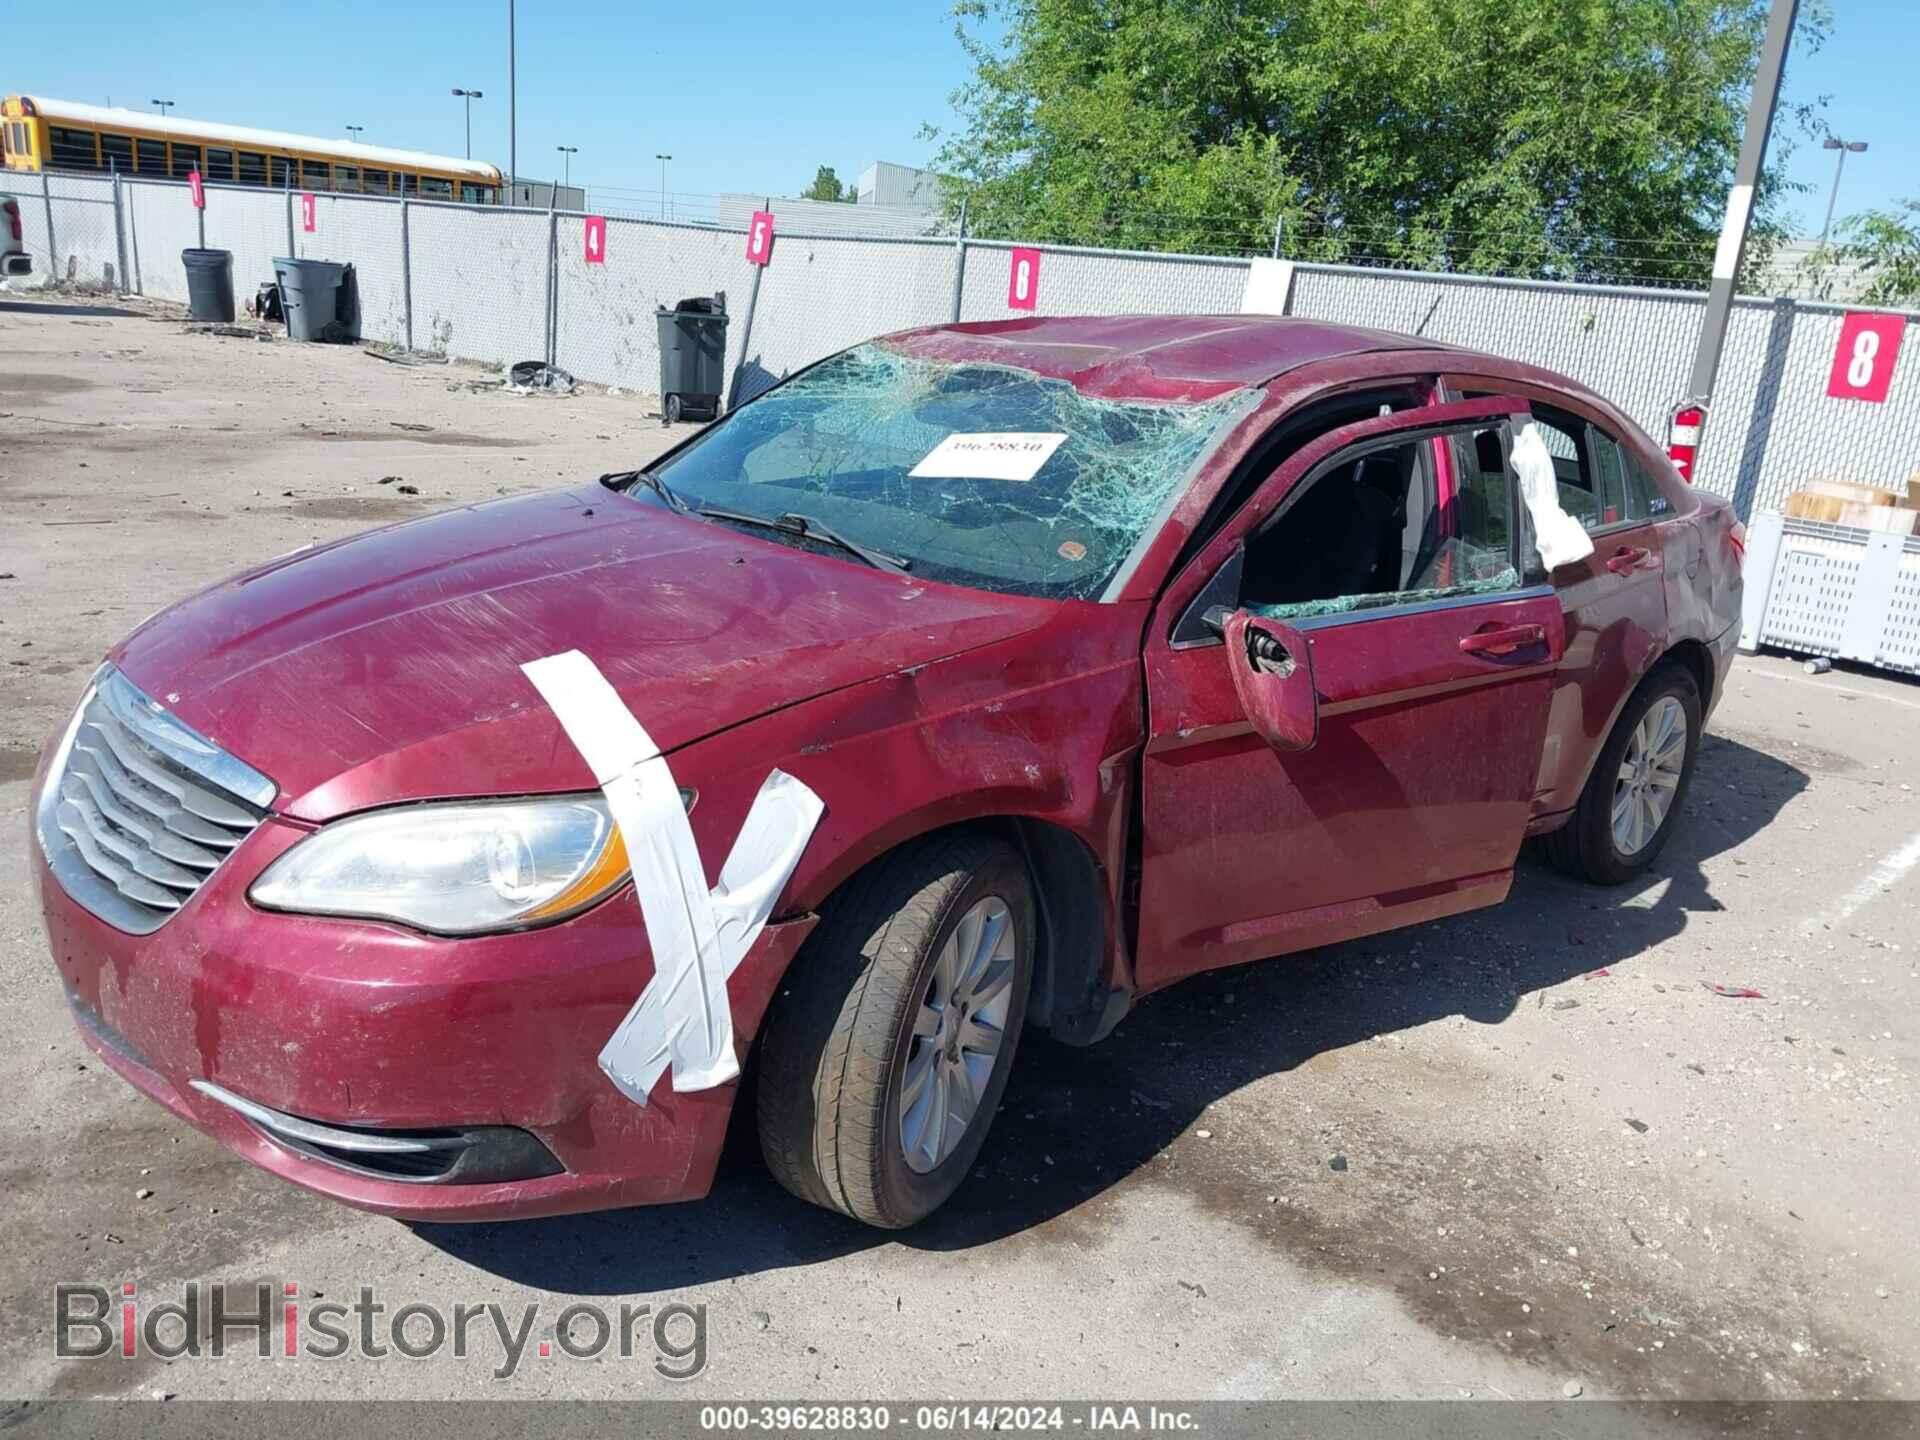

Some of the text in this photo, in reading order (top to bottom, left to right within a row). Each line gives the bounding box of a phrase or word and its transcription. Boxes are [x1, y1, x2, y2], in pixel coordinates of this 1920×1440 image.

[588, 225, 599, 256] 4
[752, 221, 765, 255] 5
[1846, 329, 1881, 389] 8
